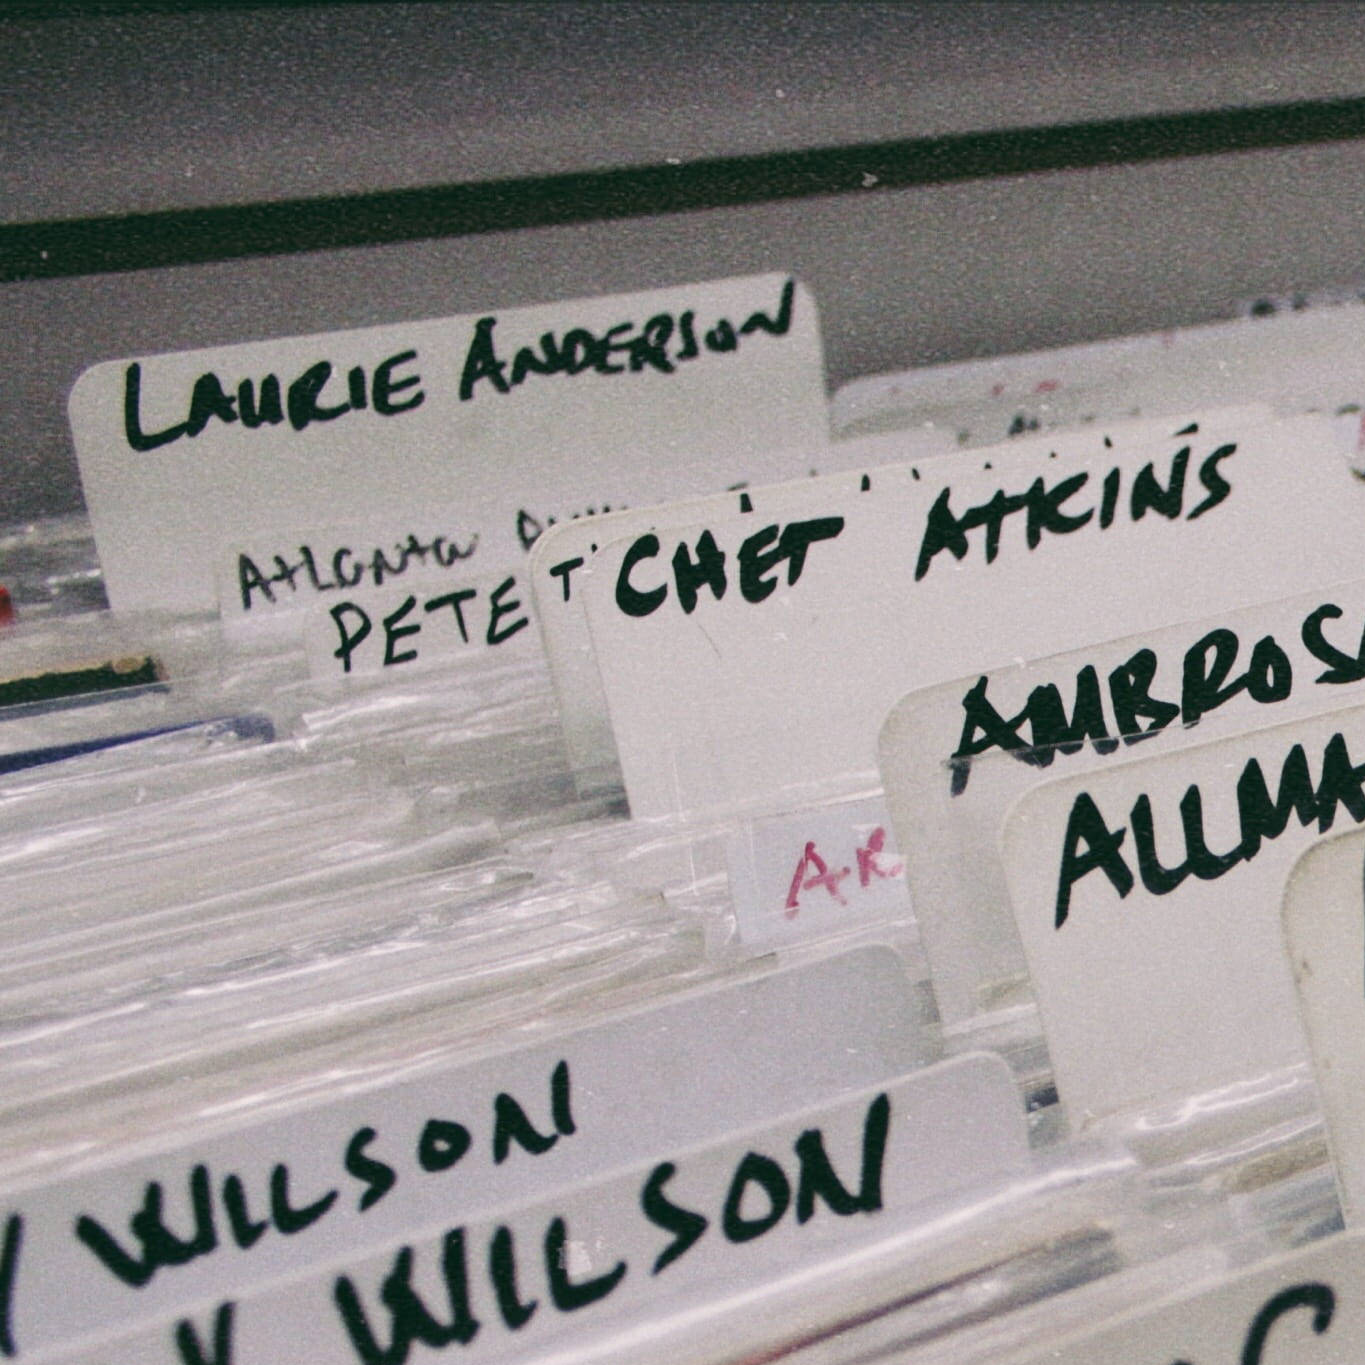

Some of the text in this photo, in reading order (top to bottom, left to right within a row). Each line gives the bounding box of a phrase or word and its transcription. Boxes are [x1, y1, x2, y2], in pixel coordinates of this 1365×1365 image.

[124, 279, 796, 452] LAURIE ANDERSON
[615, 515, 845, 618] CHET
[914, 440, 1238, 581] ATKINS
[75, 1059, 578, 1288] WILSON
